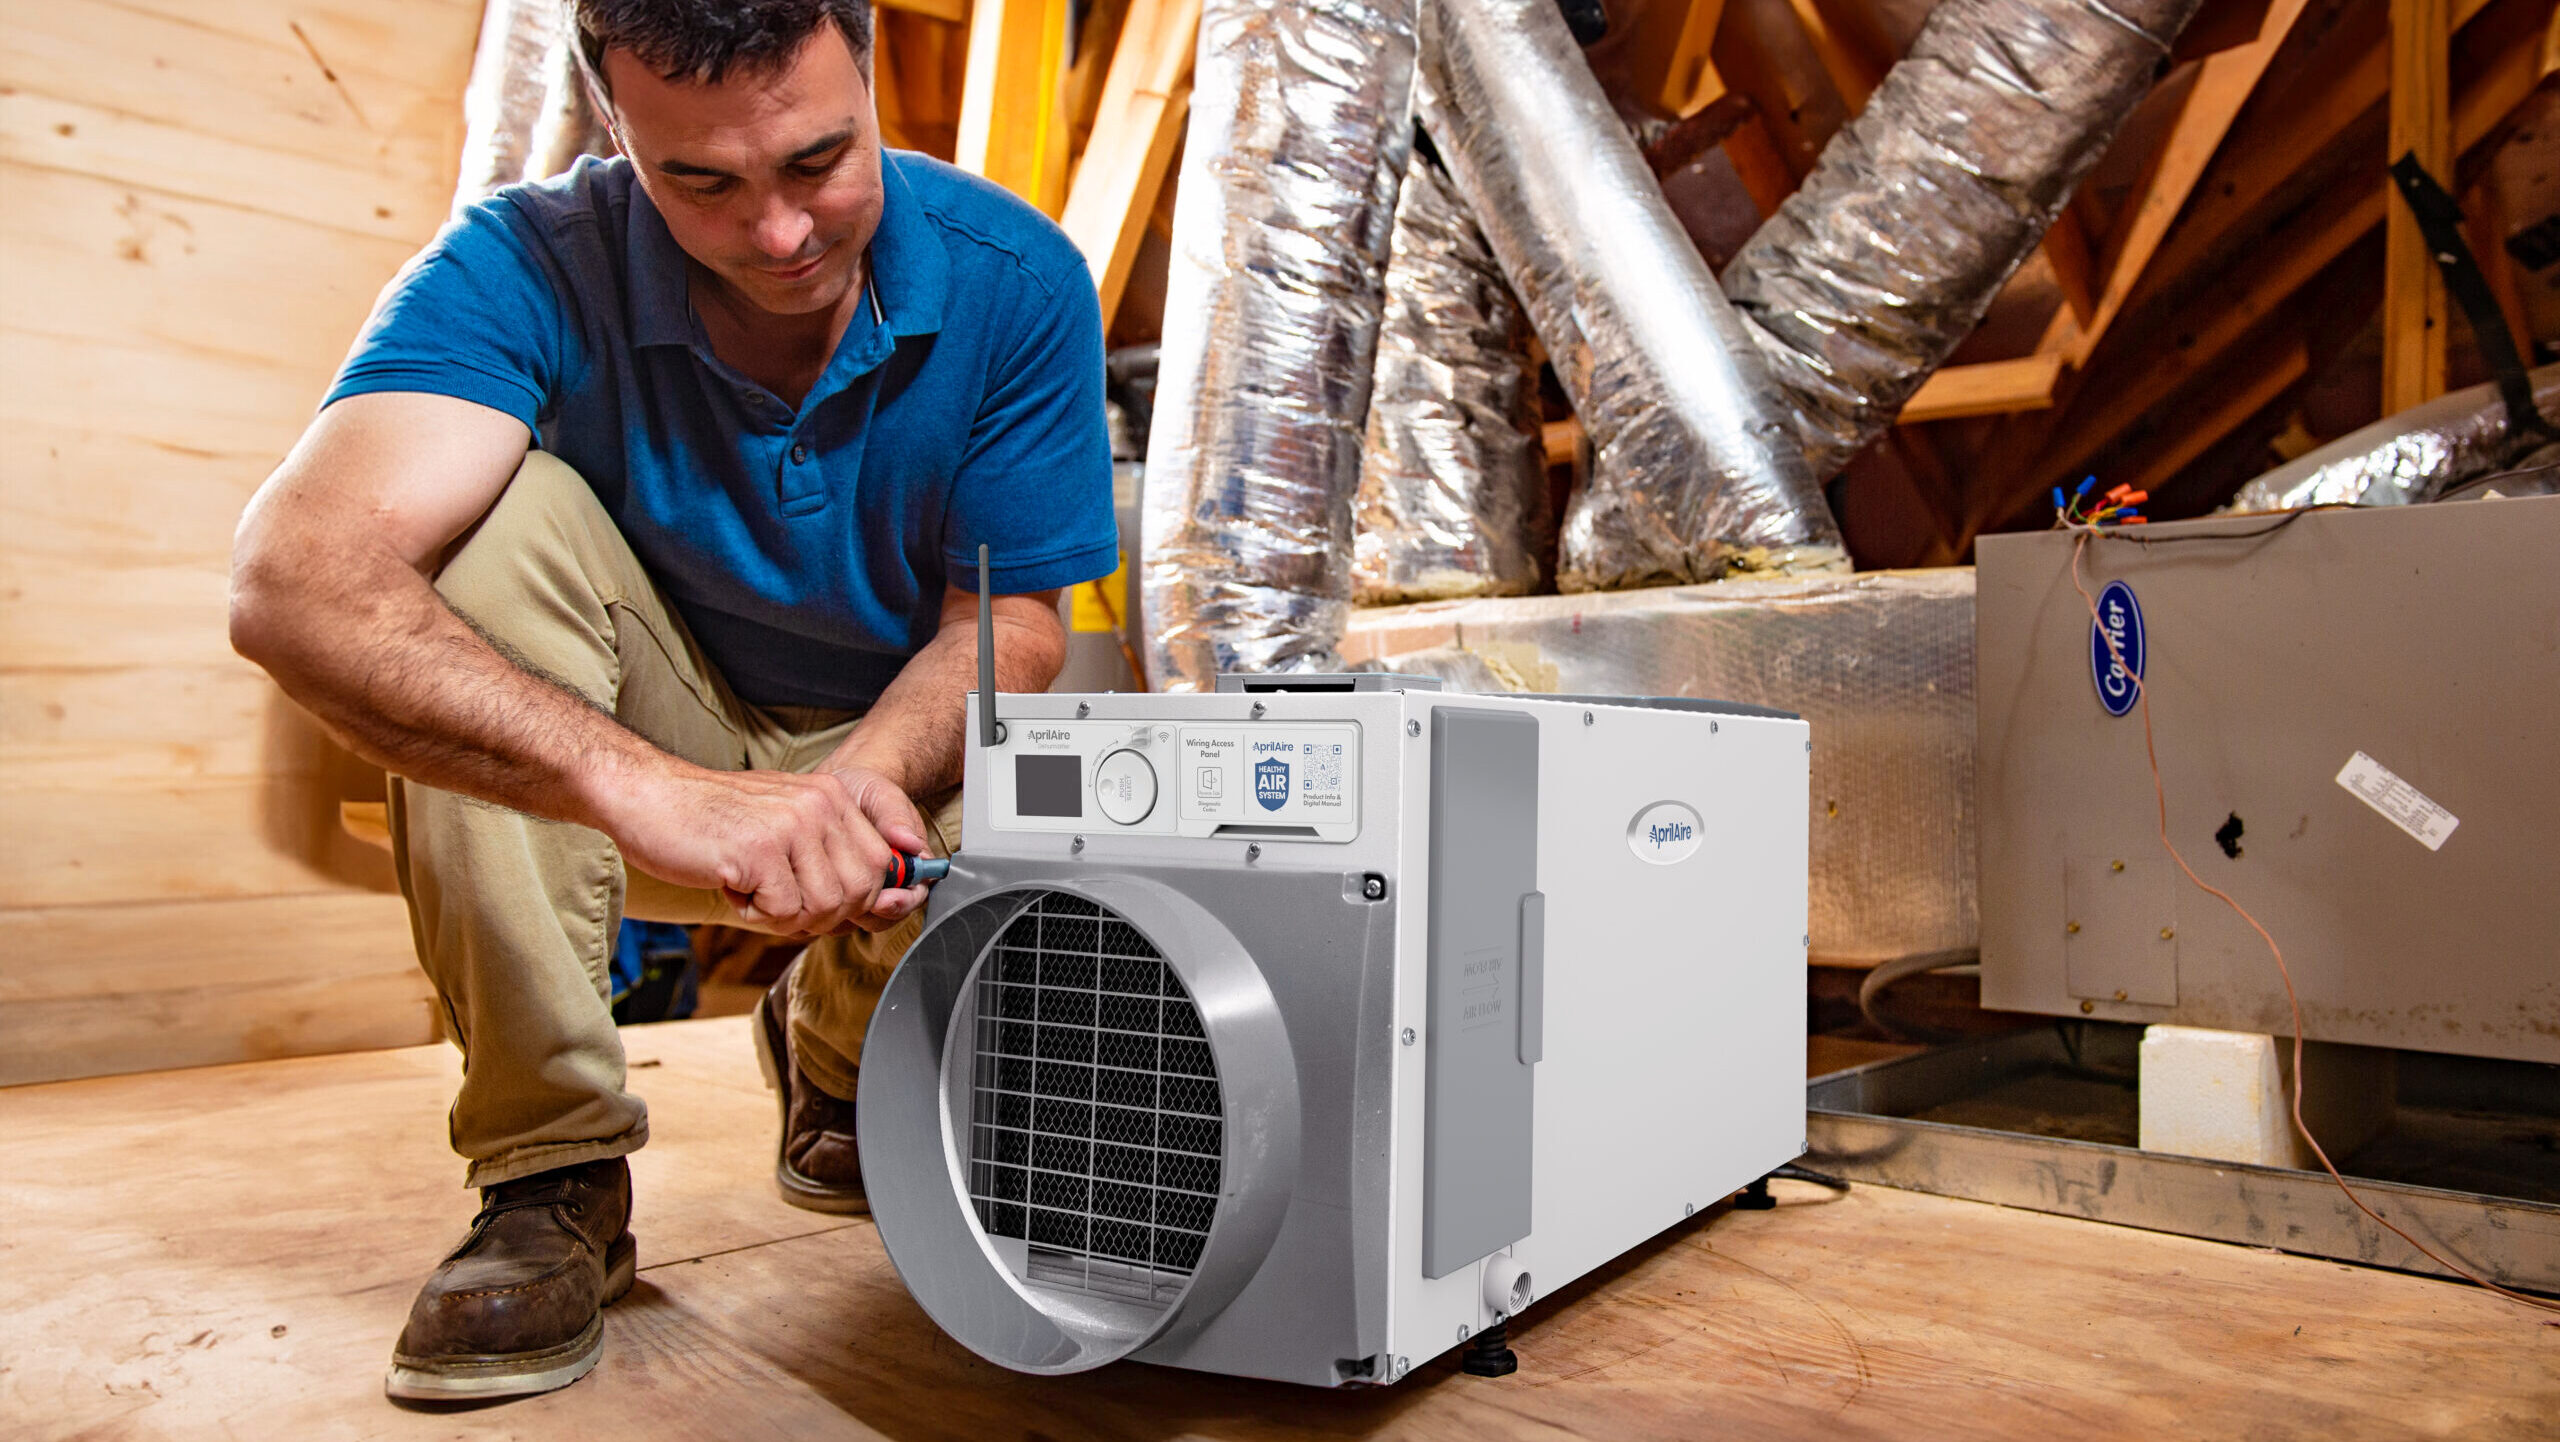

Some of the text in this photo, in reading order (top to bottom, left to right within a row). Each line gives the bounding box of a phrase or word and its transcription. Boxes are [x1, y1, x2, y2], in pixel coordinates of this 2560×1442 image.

[1027, 729, 1071, 743] AprilAire
[1186, 739, 1210, 749] Wiring
[1253, 741, 1294, 755] AprilAire
[1200, 750, 1220, 758] Panel
[1258, 765, 1286, 773] HEALTHY
[1257, 774, 1287, 790] AIR
[1258, 791, 1286, 800] SYSTEM
[1649, 822, 1692, 849] AprilAire
